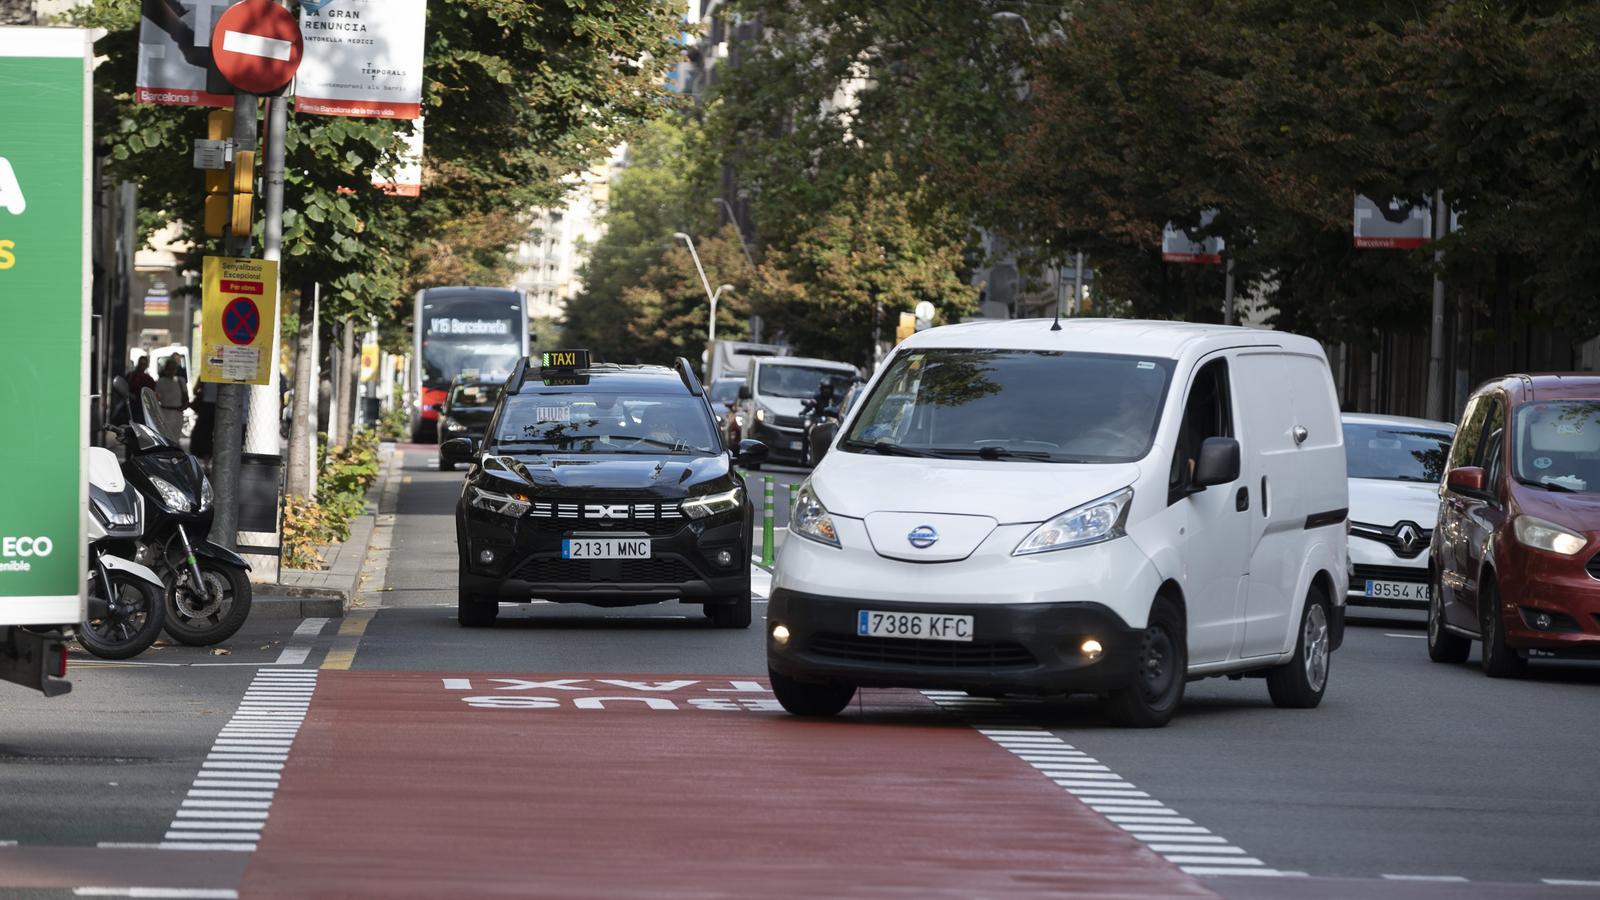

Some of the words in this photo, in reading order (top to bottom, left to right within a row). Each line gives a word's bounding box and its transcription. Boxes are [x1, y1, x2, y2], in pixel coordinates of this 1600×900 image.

[328, 9, 360, 19] GRAN
[305, 20, 367, 32] RENUNCIA
[361, 68, 407, 76] TEMPORALS
[141, 90, 190, 103] Barcelona
[452, 318, 507, 334] Barceloneta
[551, 352, 576, 366] TAXI
[2, 536, 53, 557] ECO
[573, 542, 611, 556] 2131
[618, 542, 647, 556] MNC
[1374, 583, 1410, 598] 9554
[872, 614, 922, 635] 7386
[929, 616, 968, 638] KFC
[441, 678, 774, 692] TAXI
[461, 696, 787, 711] BUS
